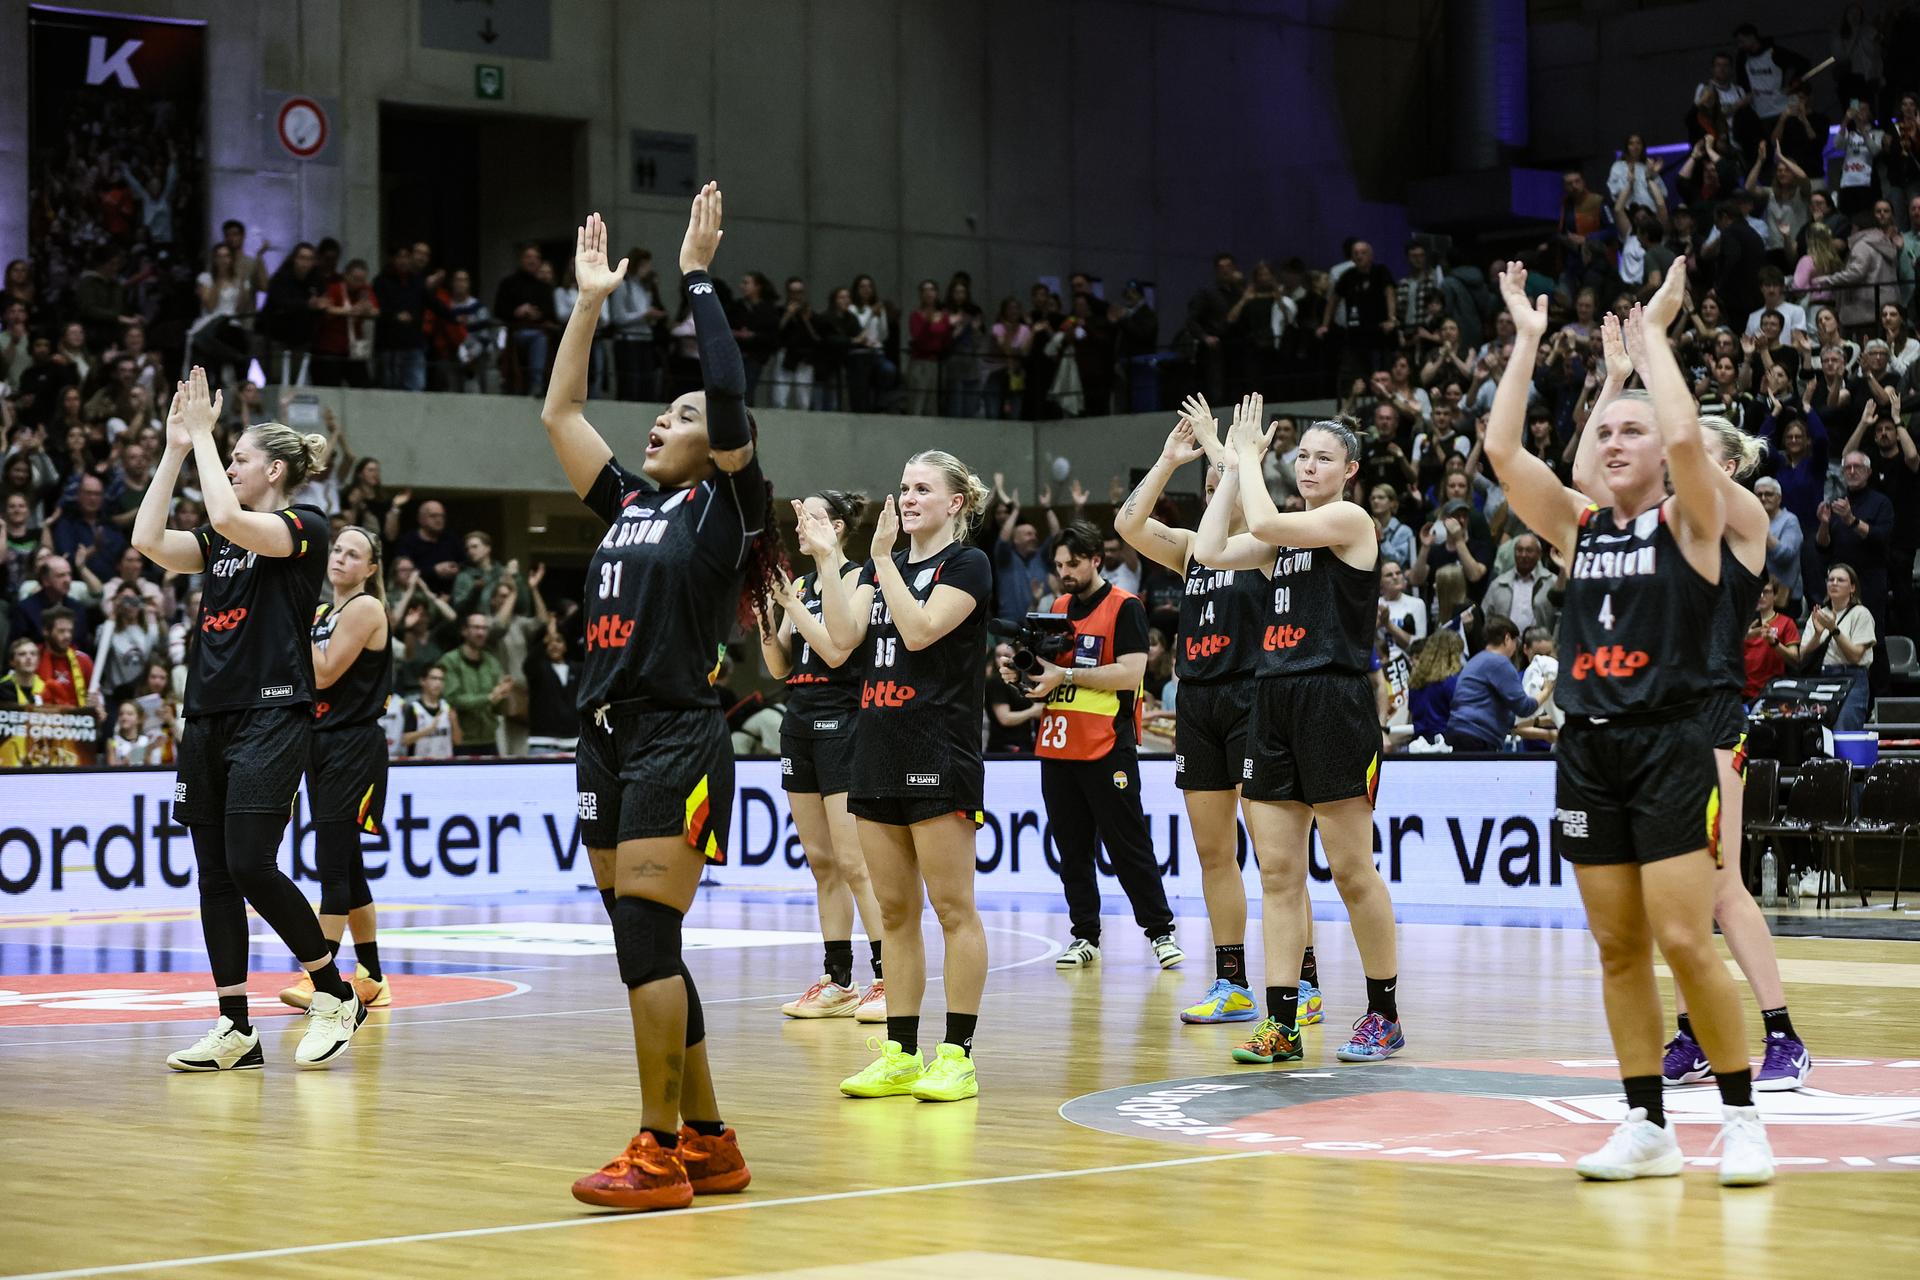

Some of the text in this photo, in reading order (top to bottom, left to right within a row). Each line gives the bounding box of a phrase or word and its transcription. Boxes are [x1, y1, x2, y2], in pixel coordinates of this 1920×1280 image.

[86, 36, 144, 89] K
[598, 561, 623, 599] 31
[1598, 594, 1615, 630] 4
[875, 638, 897, 668] 35
[1041, 716, 1068, 749] 23
[1115, 1084, 1305, 1144] EUROPEAN
